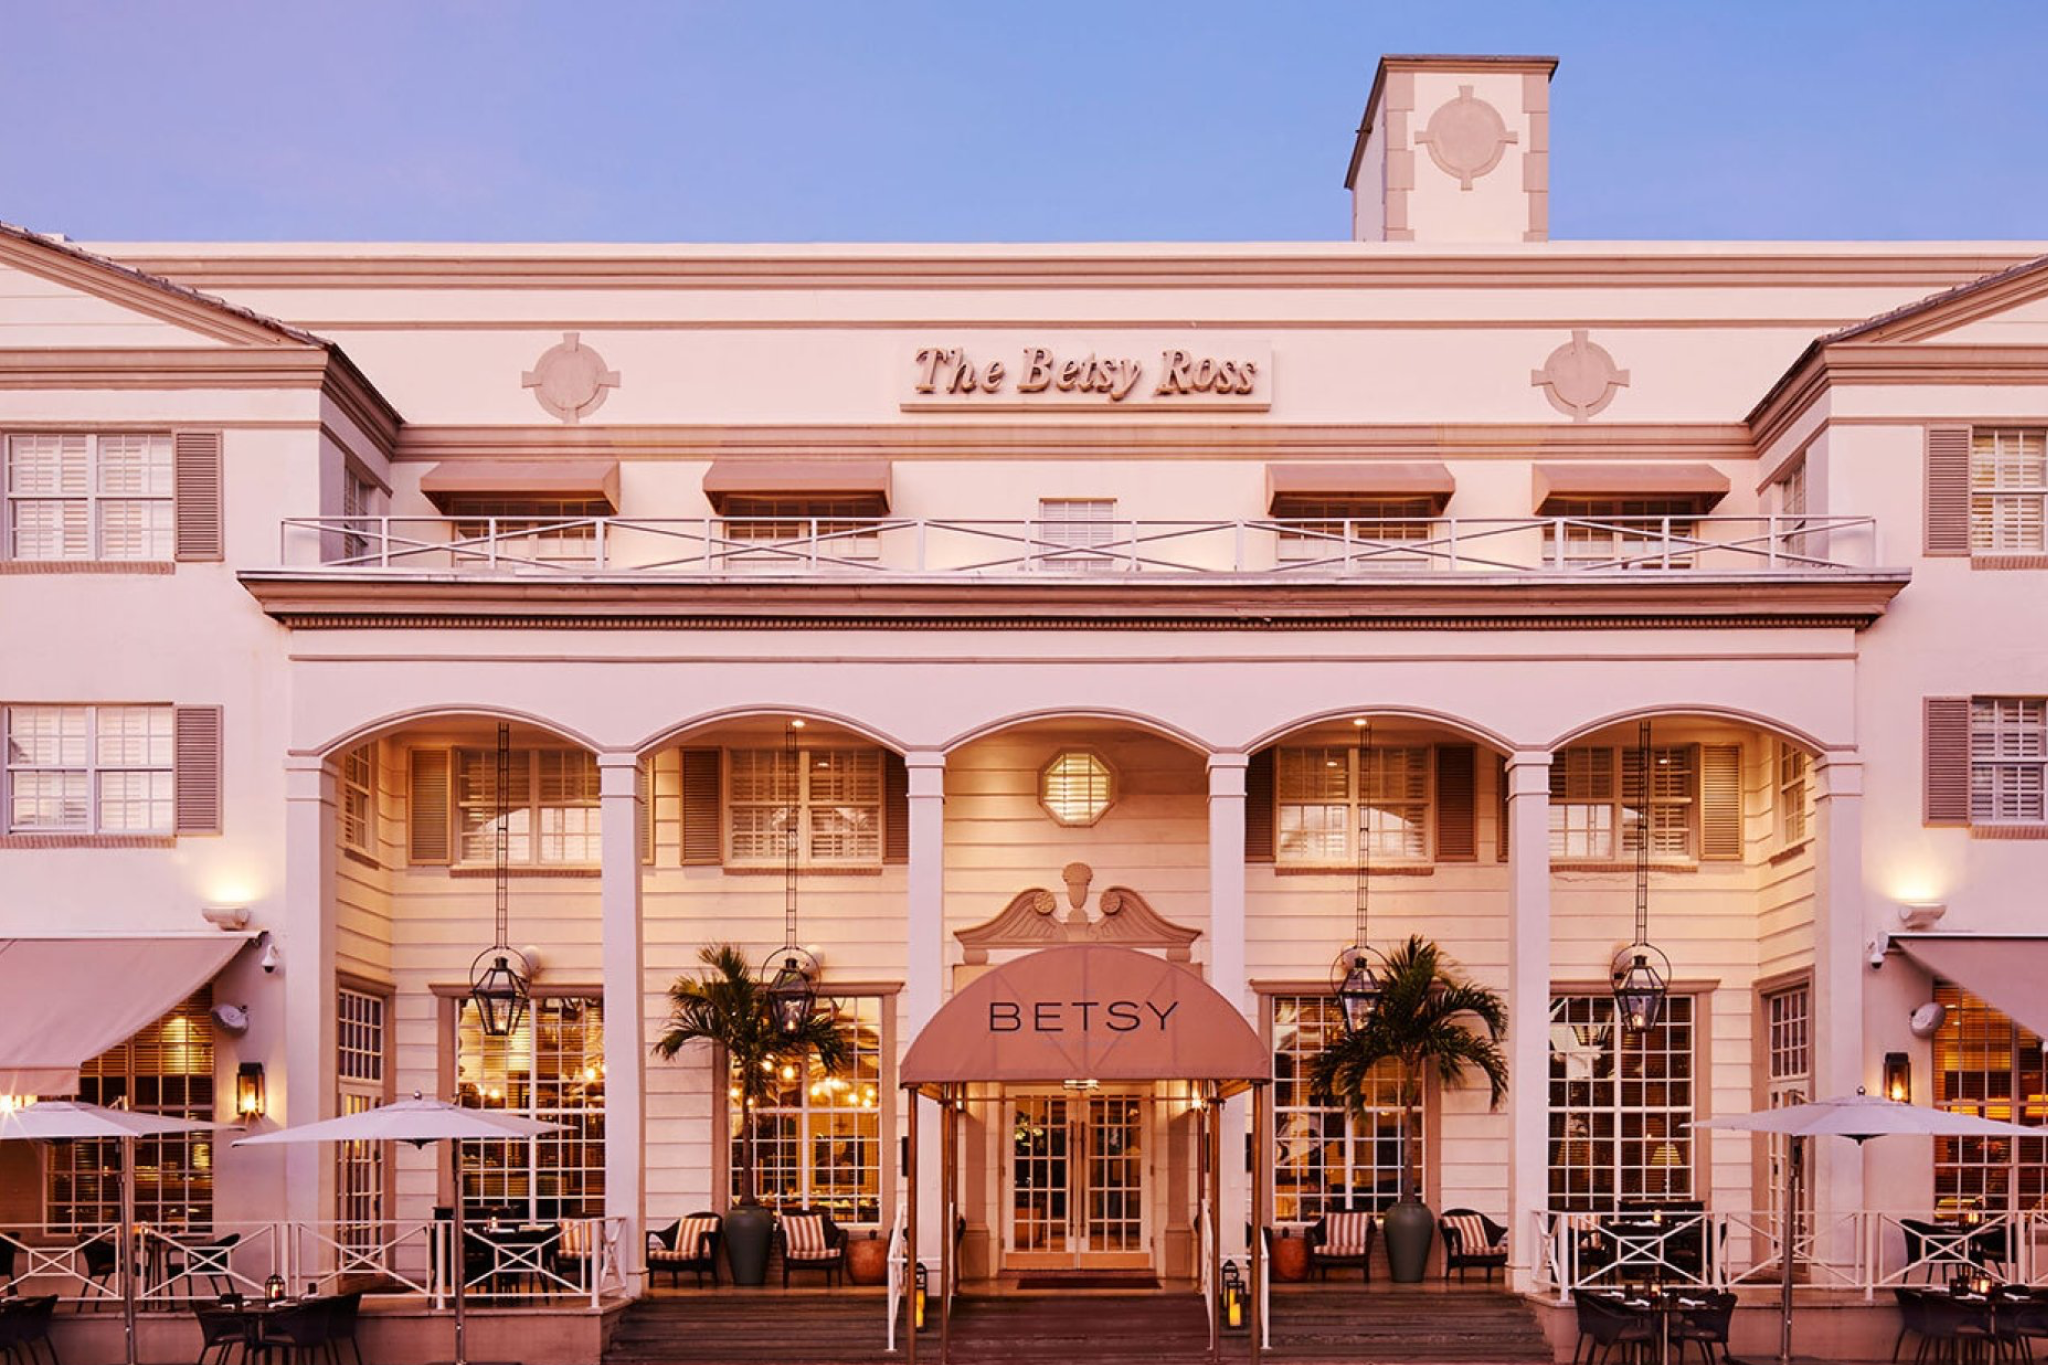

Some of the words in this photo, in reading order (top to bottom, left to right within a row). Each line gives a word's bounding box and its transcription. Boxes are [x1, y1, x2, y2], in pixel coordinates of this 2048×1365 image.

[914, 348, 1006, 395] The
[1016, 348, 1142, 401] Betsy
[1151, 348, 1258, 396] Ross
[989, 1001, 1179, 1032] BETSY
